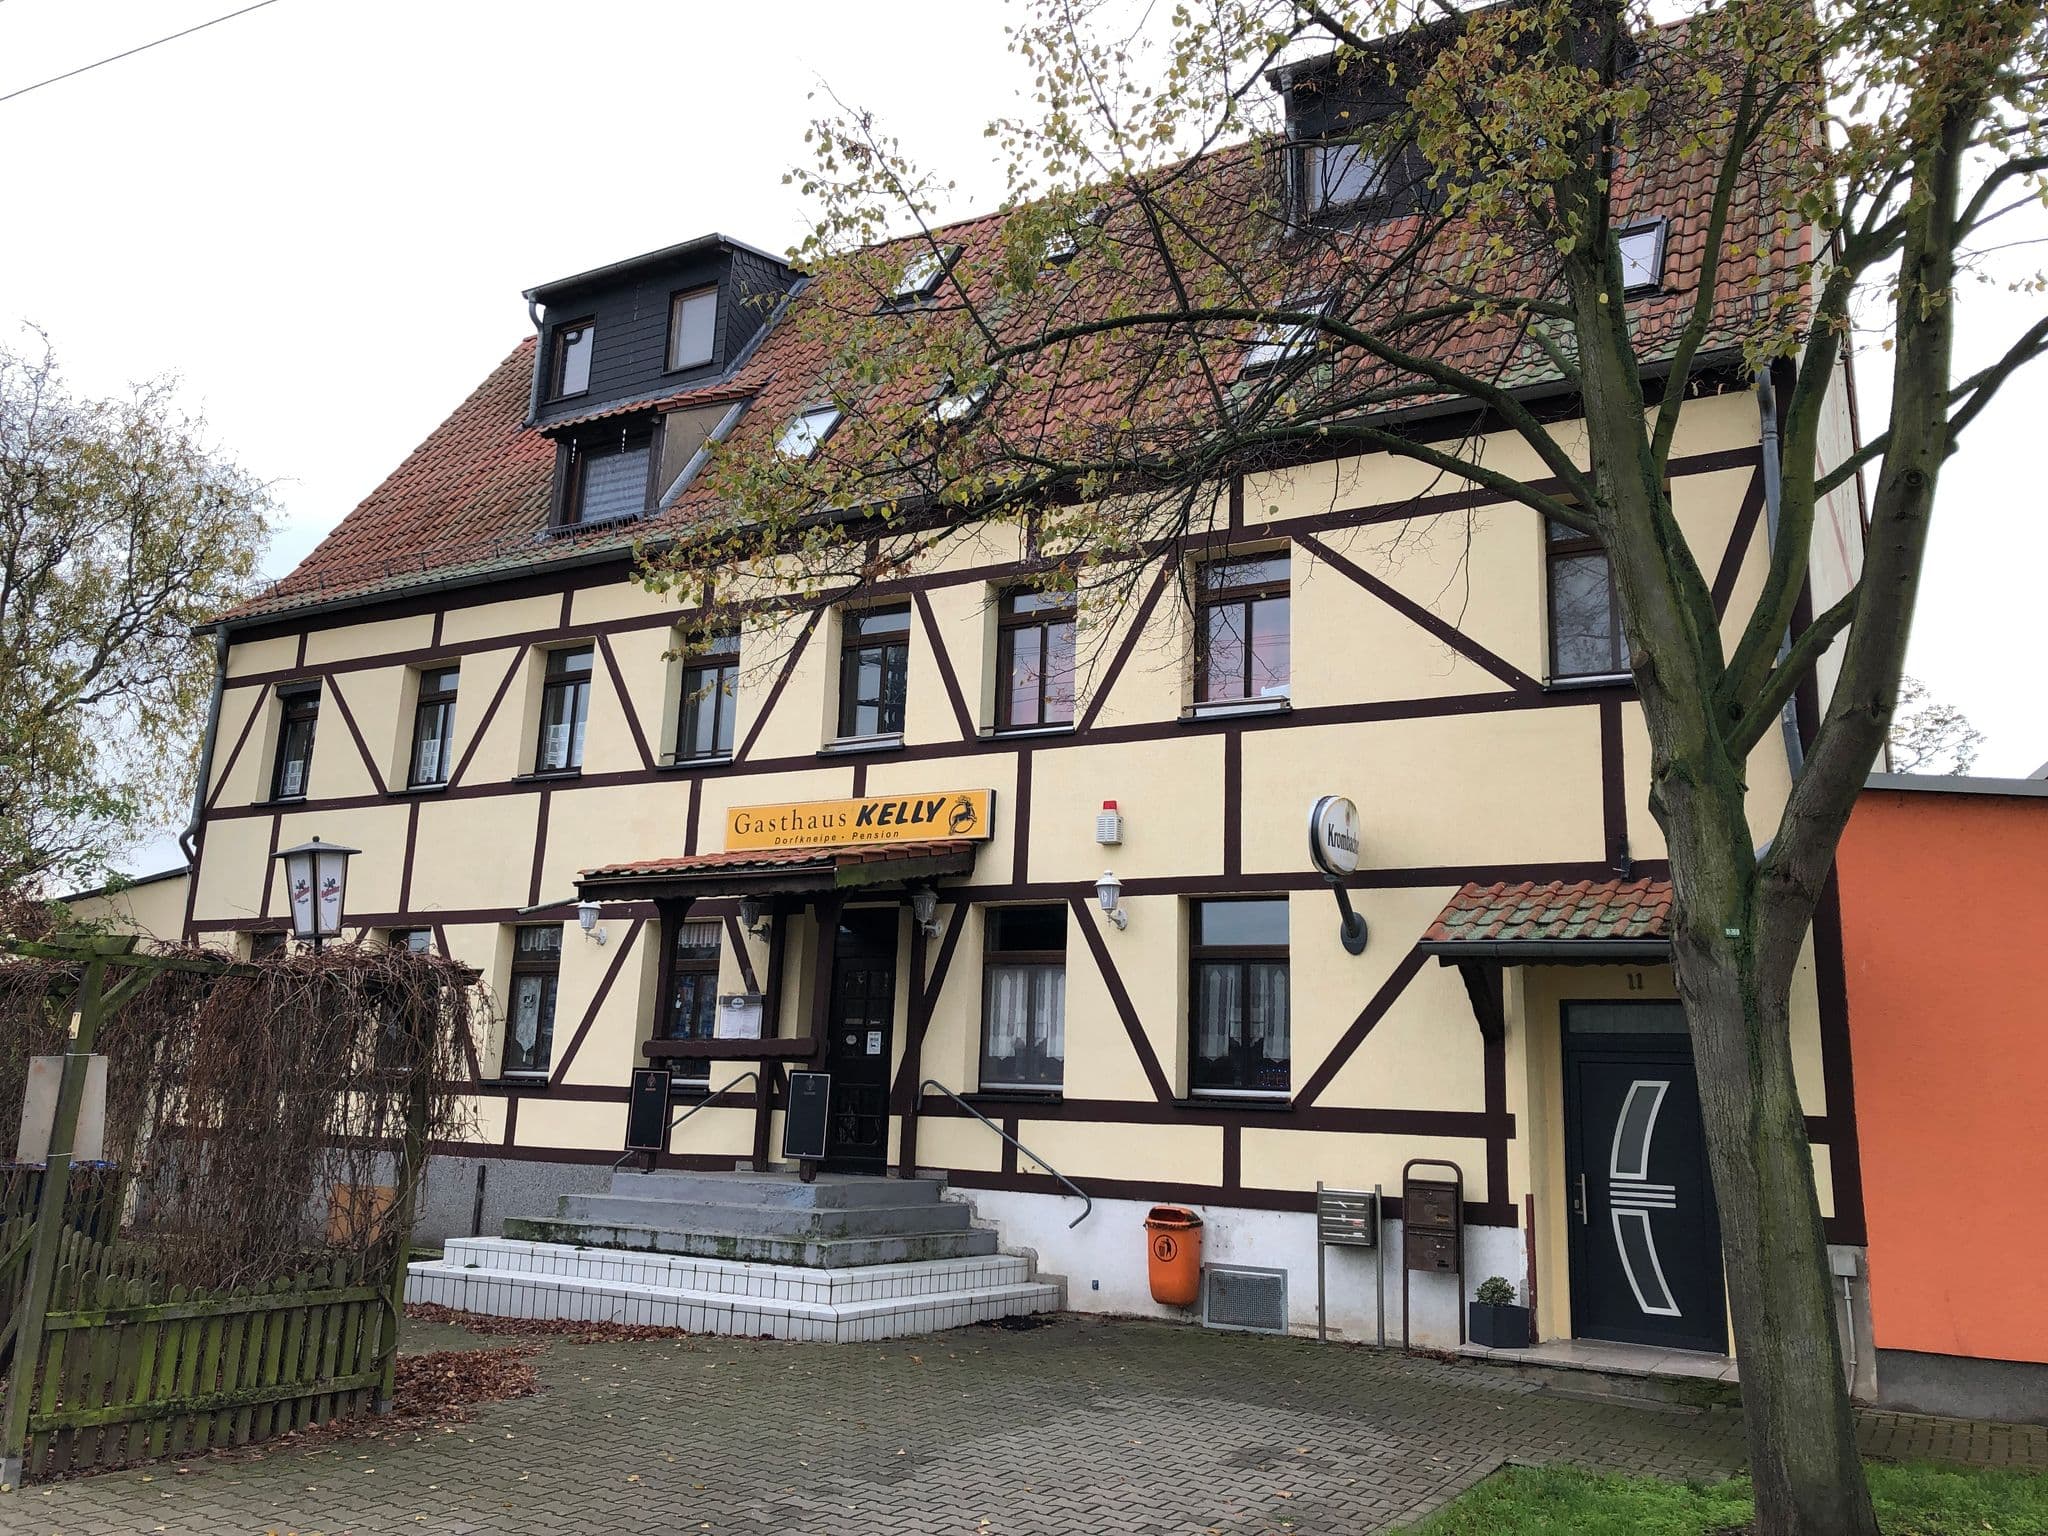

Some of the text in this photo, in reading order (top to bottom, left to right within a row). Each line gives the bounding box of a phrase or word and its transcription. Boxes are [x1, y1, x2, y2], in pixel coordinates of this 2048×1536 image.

[735, 797, 947, 835] Gasthaus KELLY
[775, 830, 900, 846] Dorfkneipe Pension
